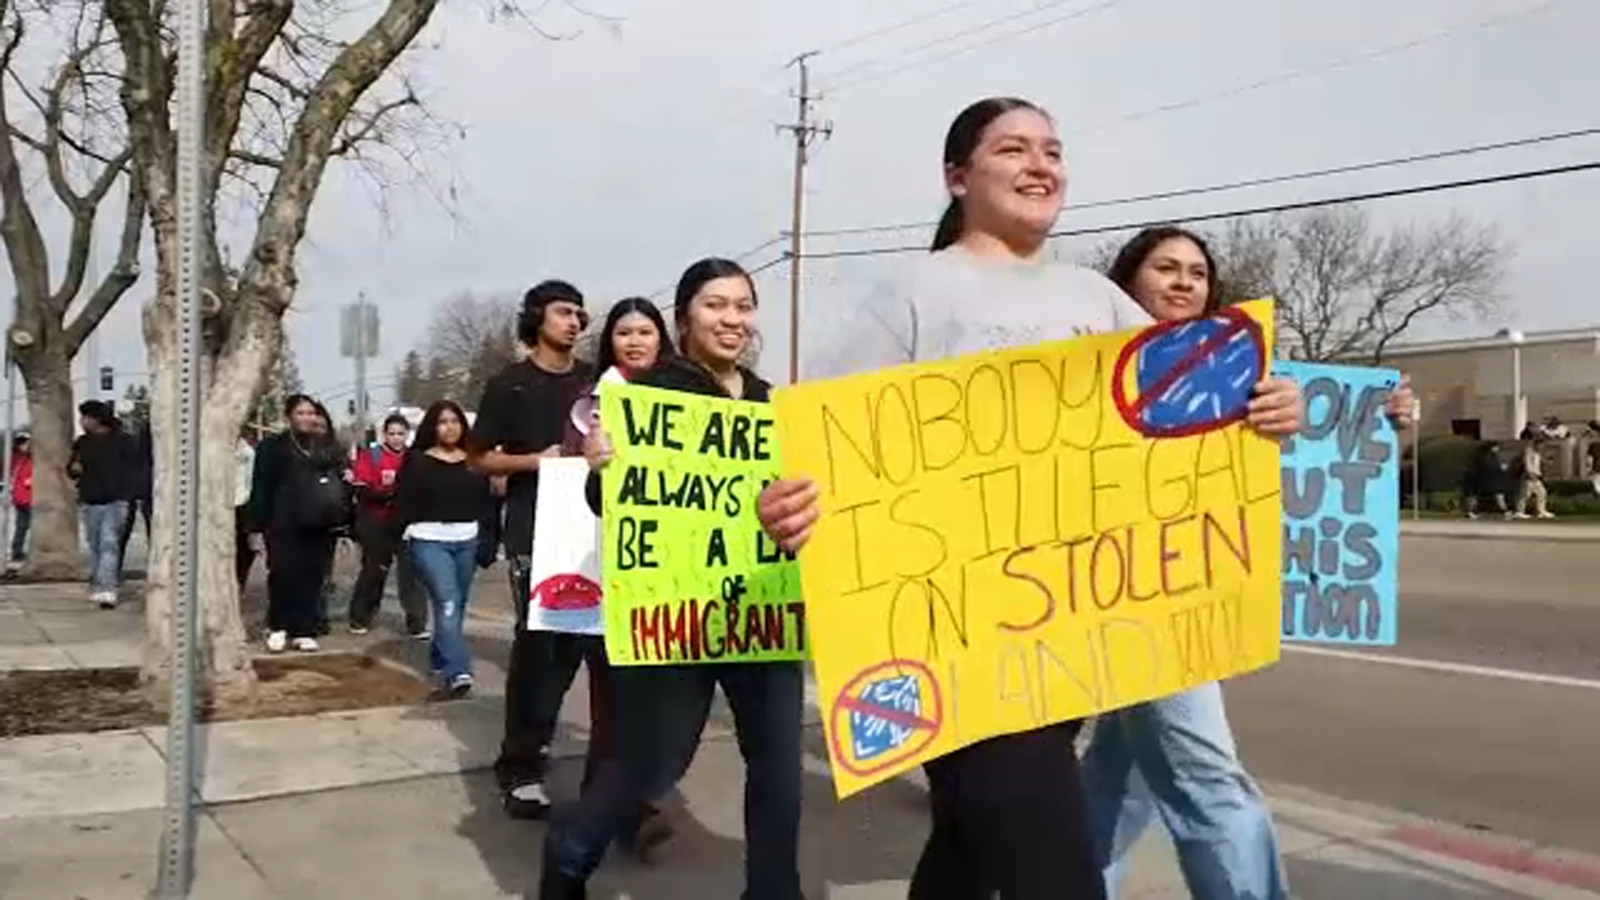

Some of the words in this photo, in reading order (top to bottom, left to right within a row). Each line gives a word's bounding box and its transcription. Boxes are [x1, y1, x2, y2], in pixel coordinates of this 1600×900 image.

[621, 397, 684, 450] WE
[699, 411, 773, 460] ARE
[822, 350, 1102, 497] NOBODY
[1281, 374, 1393, 463] OVE
[618, 466, 744, 517] ALWAYS
[834, 488, 948, 597] IS
[961, 425, 1281, 560] ILLEGAL
[1281, 462, 1382, 519] UT
[617, 516, 658, 570] BE
[706, 528, 728, 567] A
[1281, 517, 1382, 581] HiS
[722, 574, 746, 602] OF
[888, 563, 968, 675] ON
[997, 504, 1252, 632] STOLEN
[1281, 578, 1381, 640] Tion
[630, 598, 805, 660] IMMIGRANT
